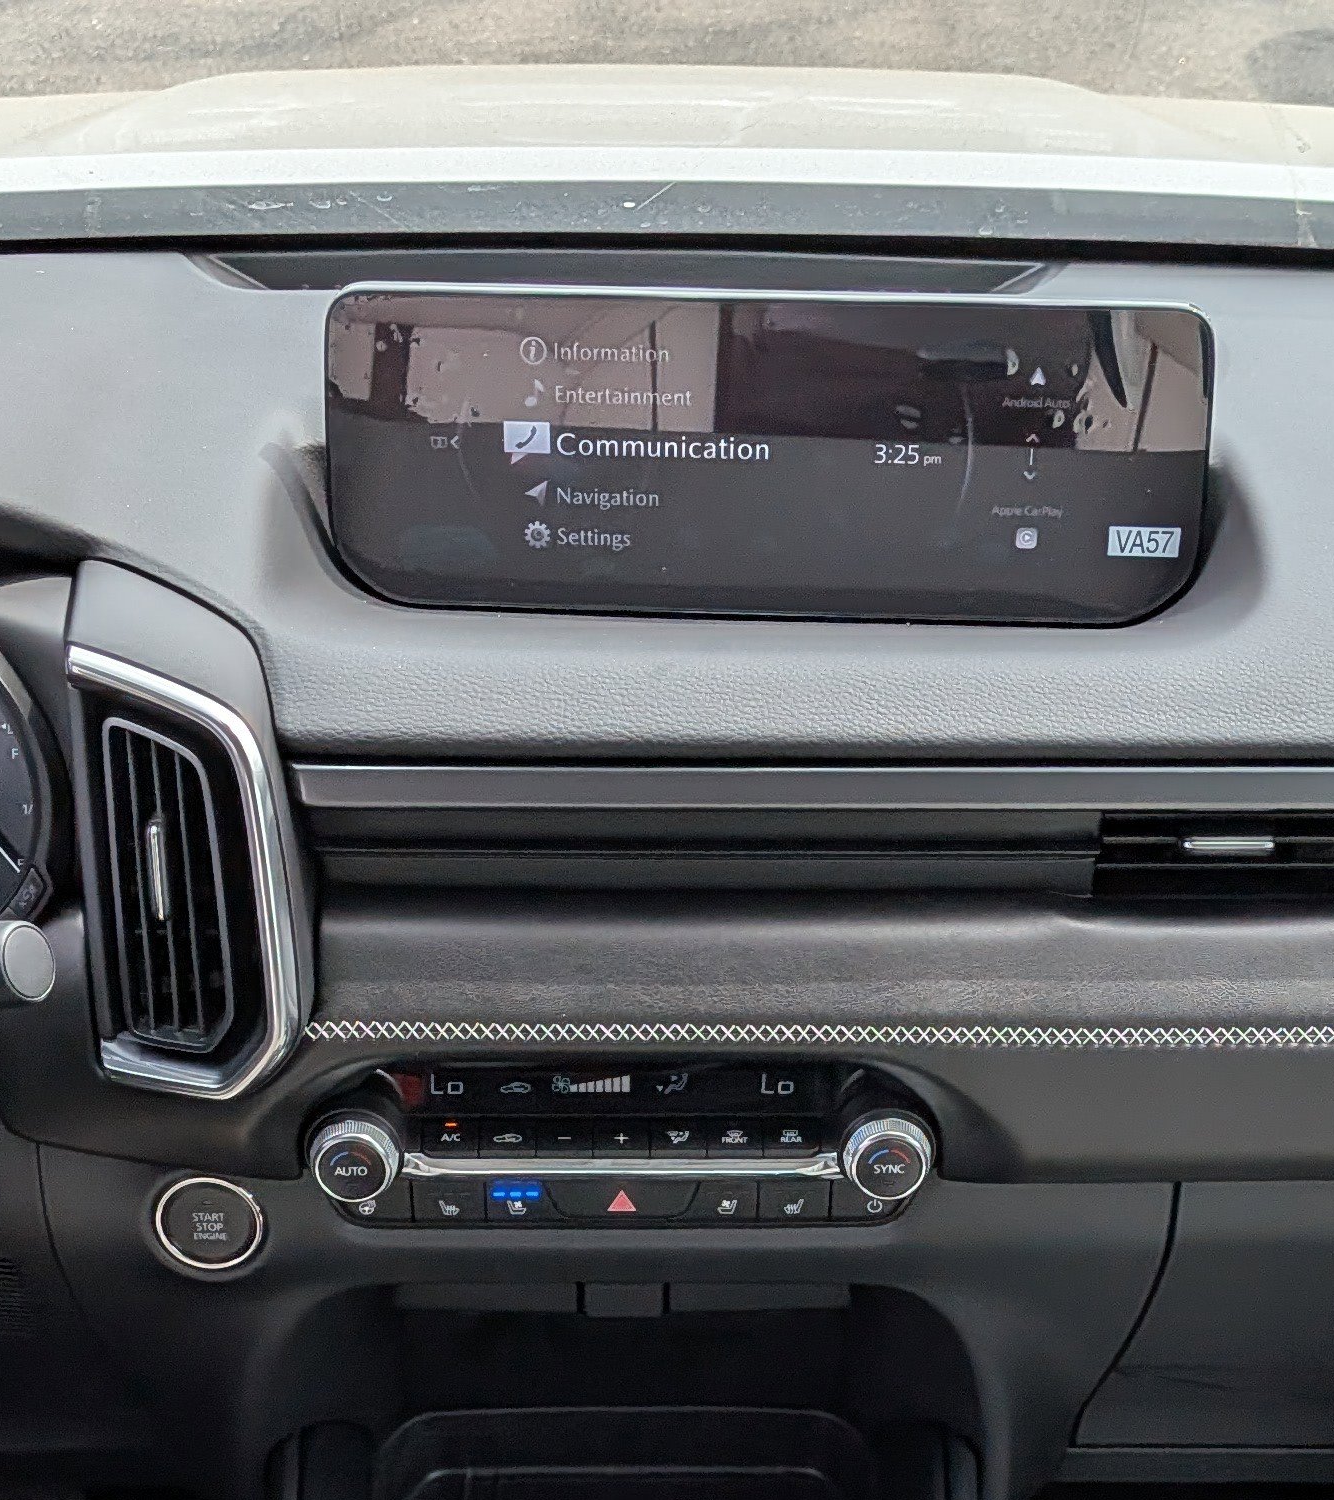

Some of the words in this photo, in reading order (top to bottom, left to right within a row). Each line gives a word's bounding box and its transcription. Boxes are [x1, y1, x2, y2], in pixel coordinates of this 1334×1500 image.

[554, 342, 669, 362] Information
[555, 386, 692, 407] Entertainment
[1002, 397, 1043, 408] Android
[557, 432, 770, 460] Communication
[874, 444, 920, 464] 3:25
[924, 455, 942, 467] pm
[557, 487, 659, 510] Navigation
[992, 506, 1022, 518] Apple
[1024, 506, 1064, 518] CarPlay
[557, 527, 631, 551] Settings
[1117, 530, 1175, 554] VA57
[440, 1133, 461, 1142] A/C
[721, 1136, 748, 1144] FRONT
[780, 1135, 802, 1143] REAR
[334, 1166, 368, 1177] AUTO
[873, 1164, 905, 1175] SYNC
[192, 1212, 224, 1222] START
[195, 1222, 224, 1231] STOP
[193, 1232, 227, 1240] ENGINE
